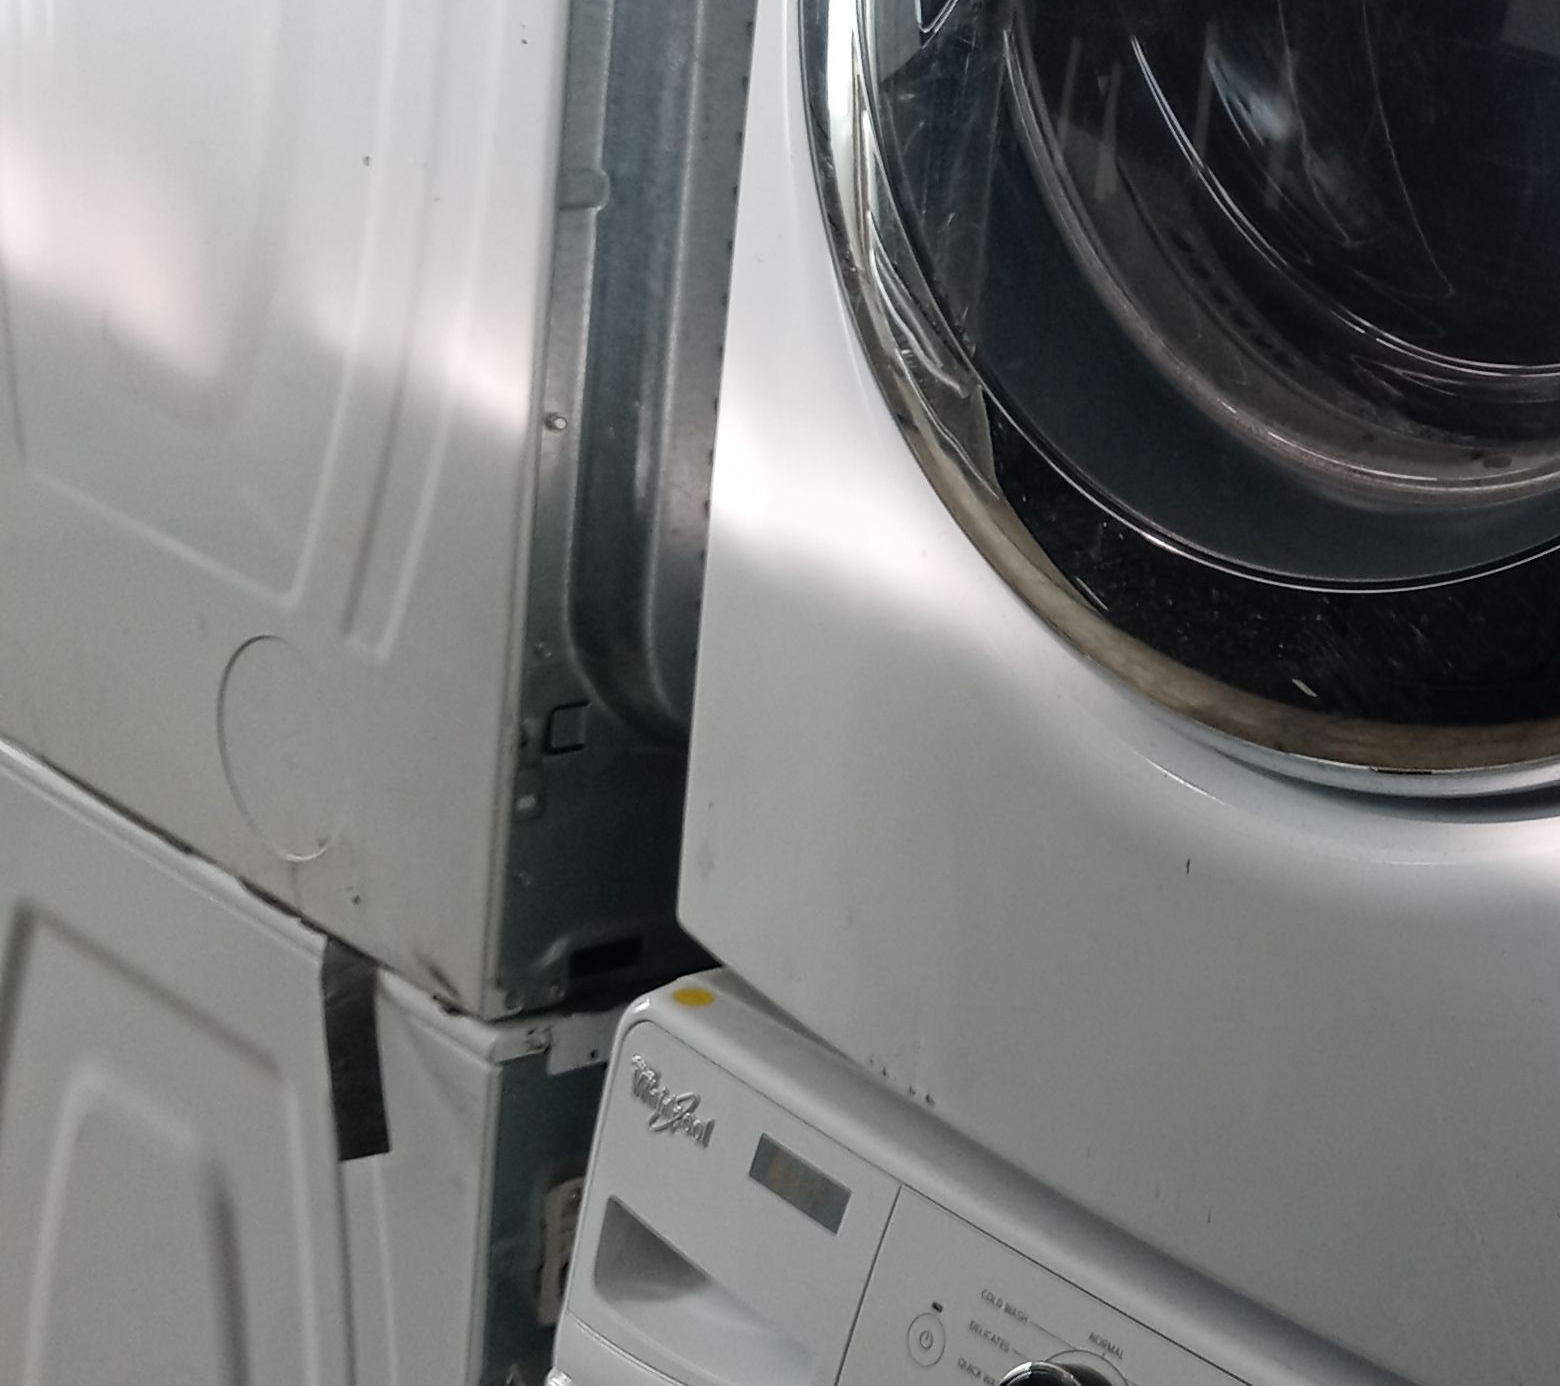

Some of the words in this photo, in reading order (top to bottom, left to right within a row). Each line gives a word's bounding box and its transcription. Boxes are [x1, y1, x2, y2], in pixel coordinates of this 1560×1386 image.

[981, 1289, 1003, 1308] COLD
[969, 1320, 1010, 1352] DELICATES
[1088, 1332, 1123, 1359] NORMAL
